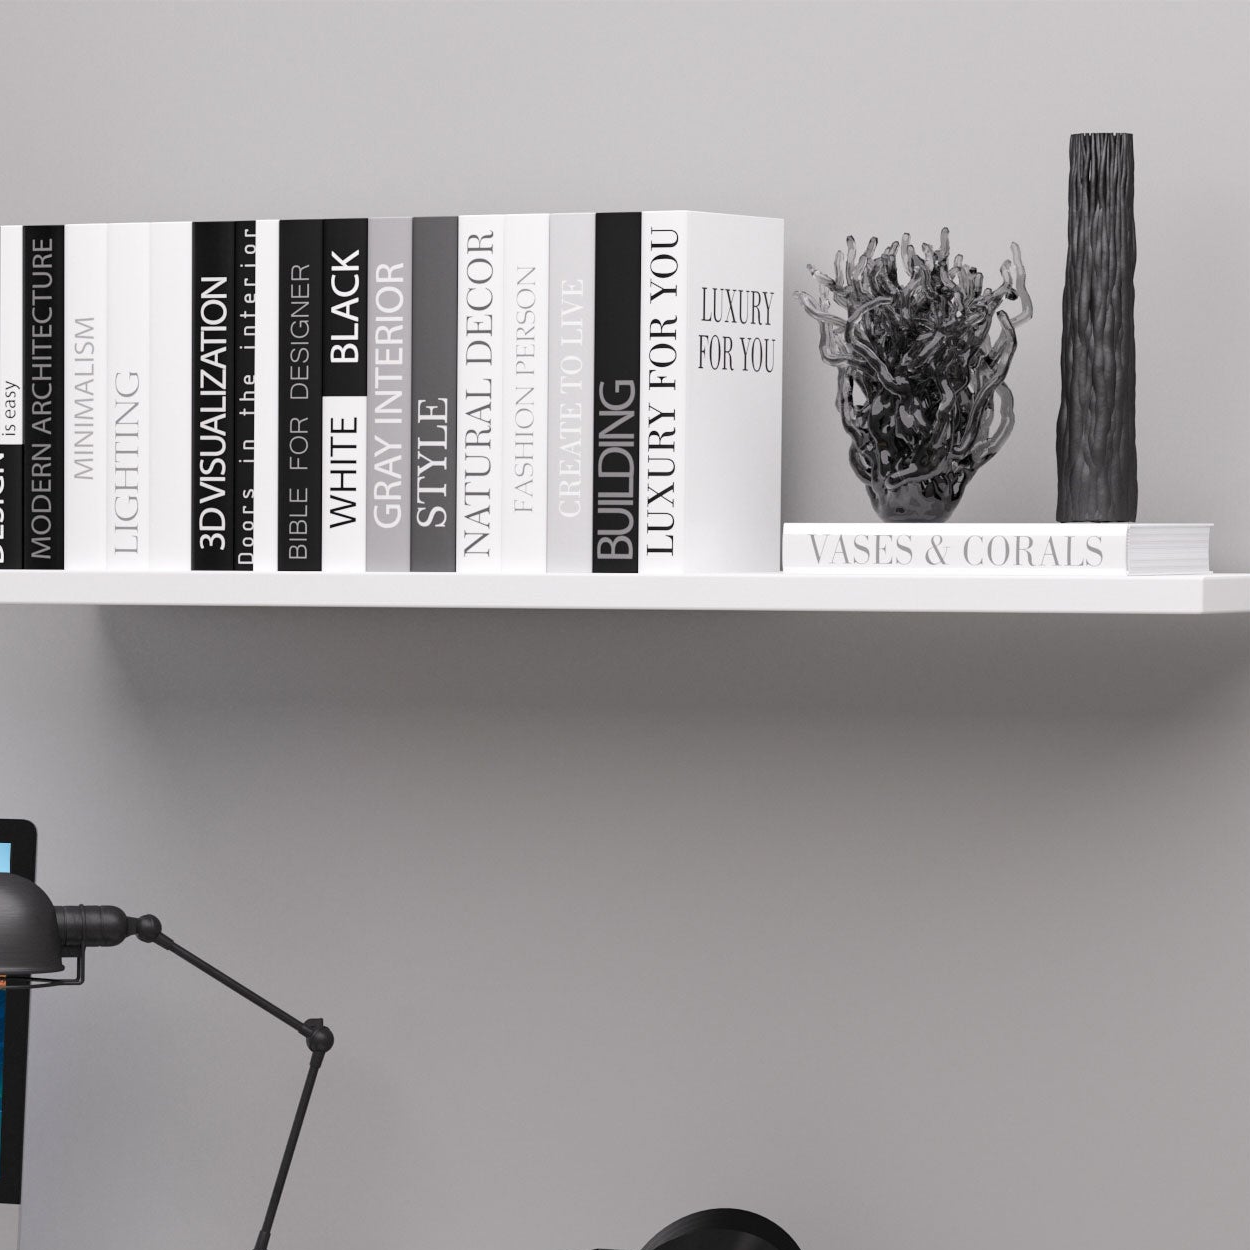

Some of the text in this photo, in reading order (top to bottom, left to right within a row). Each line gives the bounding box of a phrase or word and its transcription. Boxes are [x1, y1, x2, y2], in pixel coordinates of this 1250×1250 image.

[238, 229, 256, 565] Doors in the interior
[330, 250, 360, 363] BLACK
[374, 262, 404, 529] GRAY INTERIOR
[464, 229, 494, 557] NATURAL DECOR
[514, 266, 536, 513] FASHION PERSON
[646, 226, 679, 556] LUXURY FOR YOU
[698, 334, 776, 373] FOR YOU
[701, 287, 774, 326] LUXURY
[2, 380, 20, 437] is easy
[31, 238, 53, 559] MODERN ARCHITECTURE
[74, 317, 95, 480] MINIMALISM
[115, 371, 139, 554] LIGHTING
[199, 276, 228, 551] 3D VISUALIZATION
[289, 264, 310, 560] BIBLE FOR DESIGNER
[330, 417, 357, 529] WHITE
[416, 398, 448, 527] STYLE
[558, 279, 584, 518] CREATE TO LIVE
[597, 379, 636, 560] BUILDING
[808, 533, 1103, 568] VASES & CORALS
